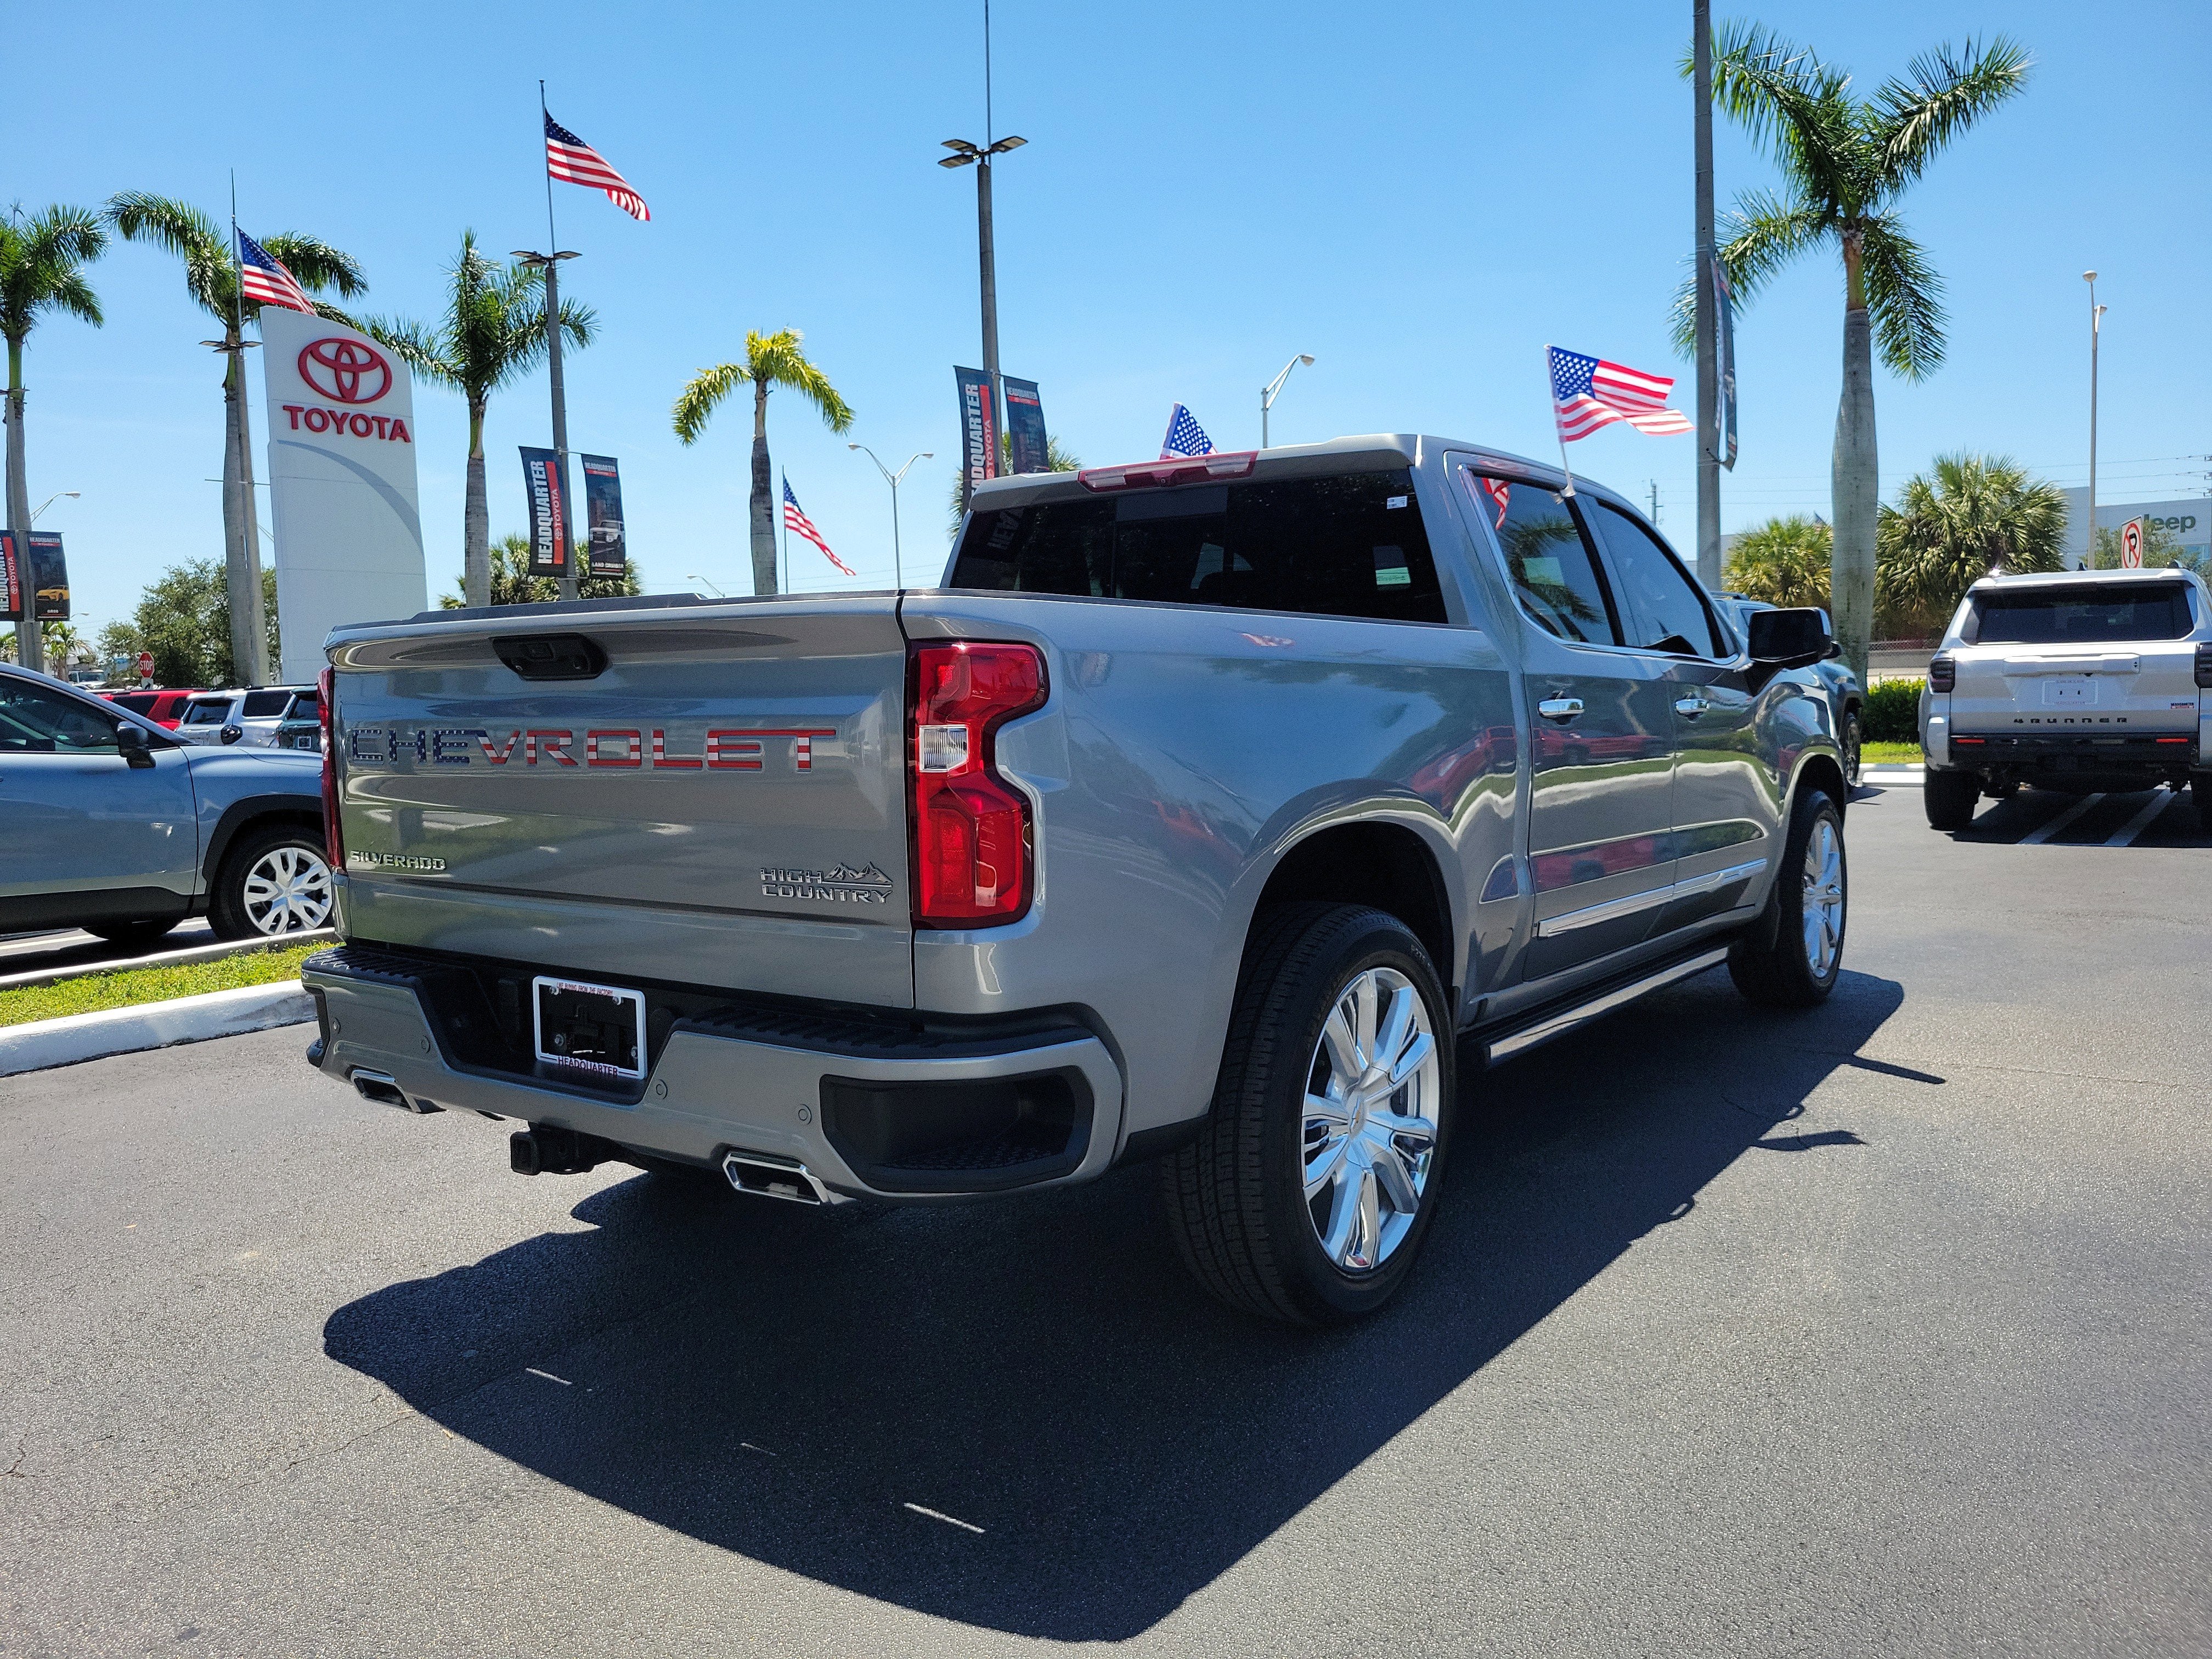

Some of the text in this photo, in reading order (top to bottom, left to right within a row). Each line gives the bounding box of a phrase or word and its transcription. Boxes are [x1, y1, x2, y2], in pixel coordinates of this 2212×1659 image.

[283, 405, 412, 443] TOYOTA
[984, 420, 995, 467] TOYOTA
[530, 461, 554, 564] HEADQUARTER
[550, 488, 562, 526] TOYOTA
[8, 557, 16, 584] TOYOTA
[140, 660, 153, 671] STOP
[352, 728, 837, 772] CHEVROLET
[350, 850, 447, 870] SILVERADO
[760, 867, 823, 884] HIGH
[762, 884, 893, 904] COUNTRY
[558, 1057, 618, 1076] HEADQUARTER
